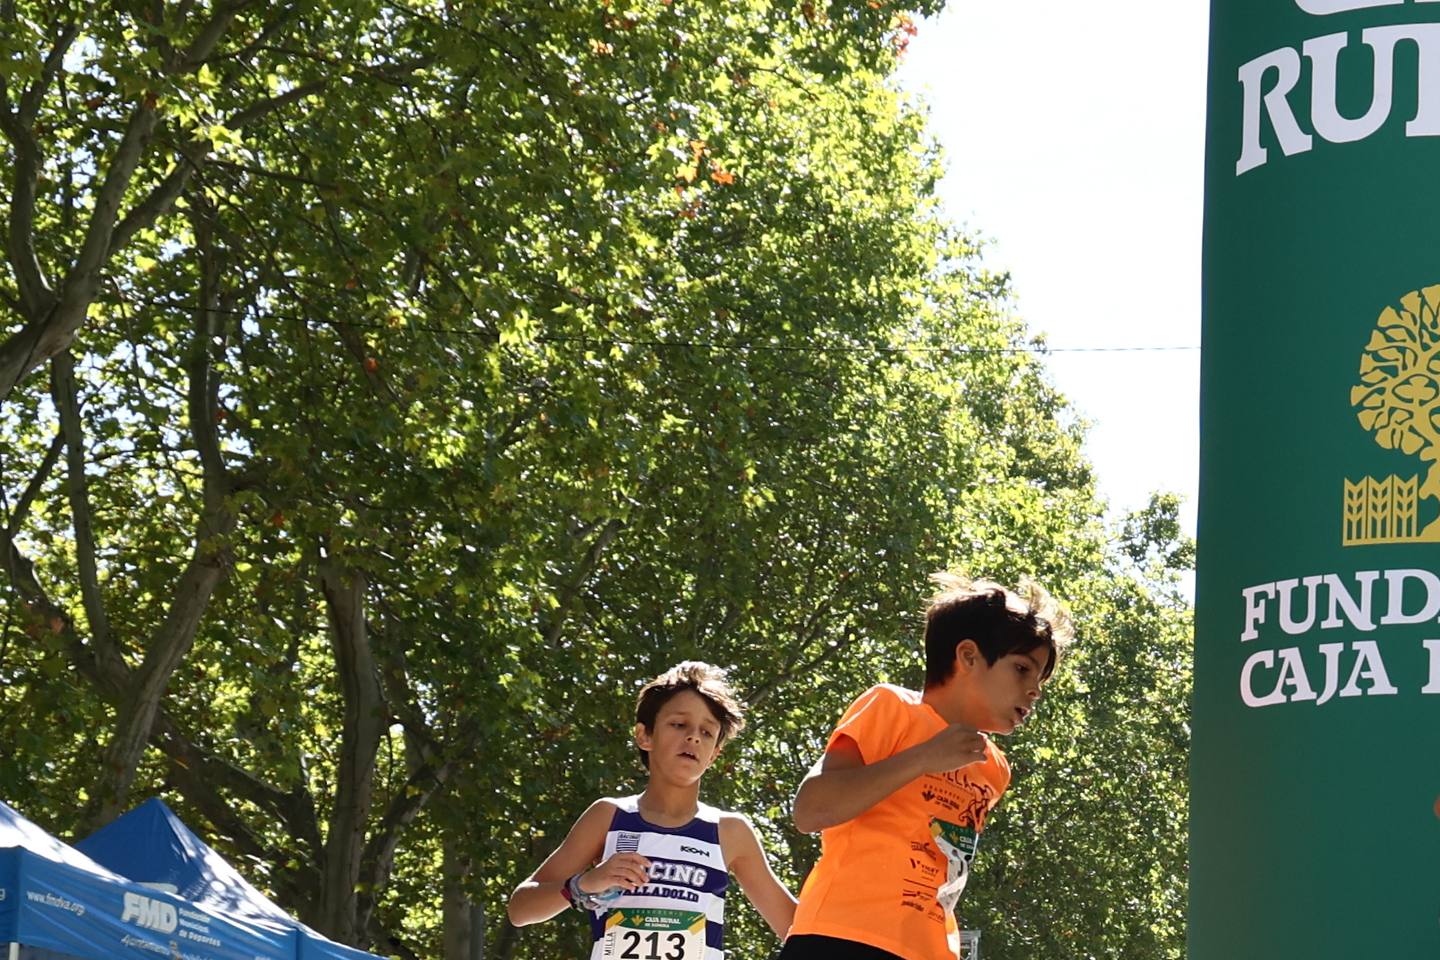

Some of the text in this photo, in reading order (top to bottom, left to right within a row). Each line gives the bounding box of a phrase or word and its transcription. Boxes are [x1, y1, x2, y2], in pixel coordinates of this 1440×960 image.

[1239, 639, 1398, 708] CAJA
[641, 861, 708, 887] CING
[121, 892, 178, 935] FMD
[605, 932, 615, 956] MILLA
